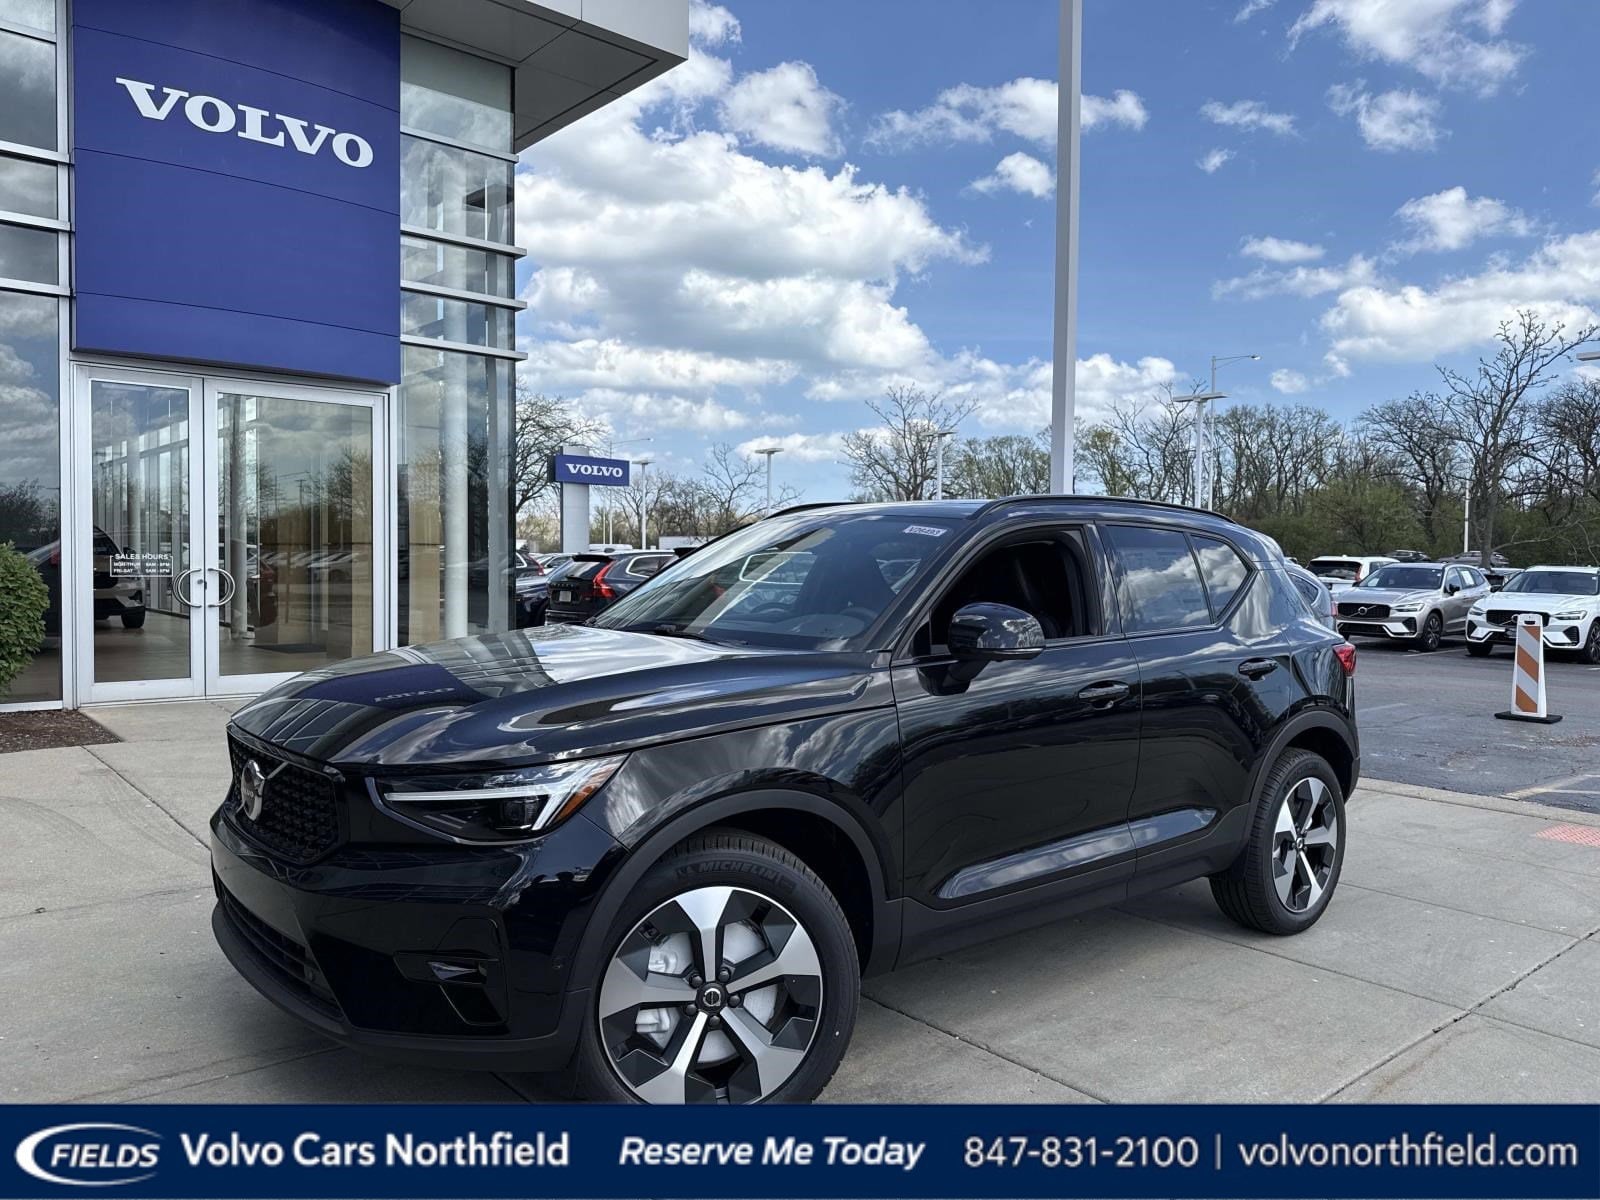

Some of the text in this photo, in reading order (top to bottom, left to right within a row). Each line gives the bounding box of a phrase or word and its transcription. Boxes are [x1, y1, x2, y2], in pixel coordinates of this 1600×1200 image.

[115, 76, 374, 168] VOLVO
[566, 463, 623, 477] VOLVO
[697, 860, 778, 880] MICHELIN
